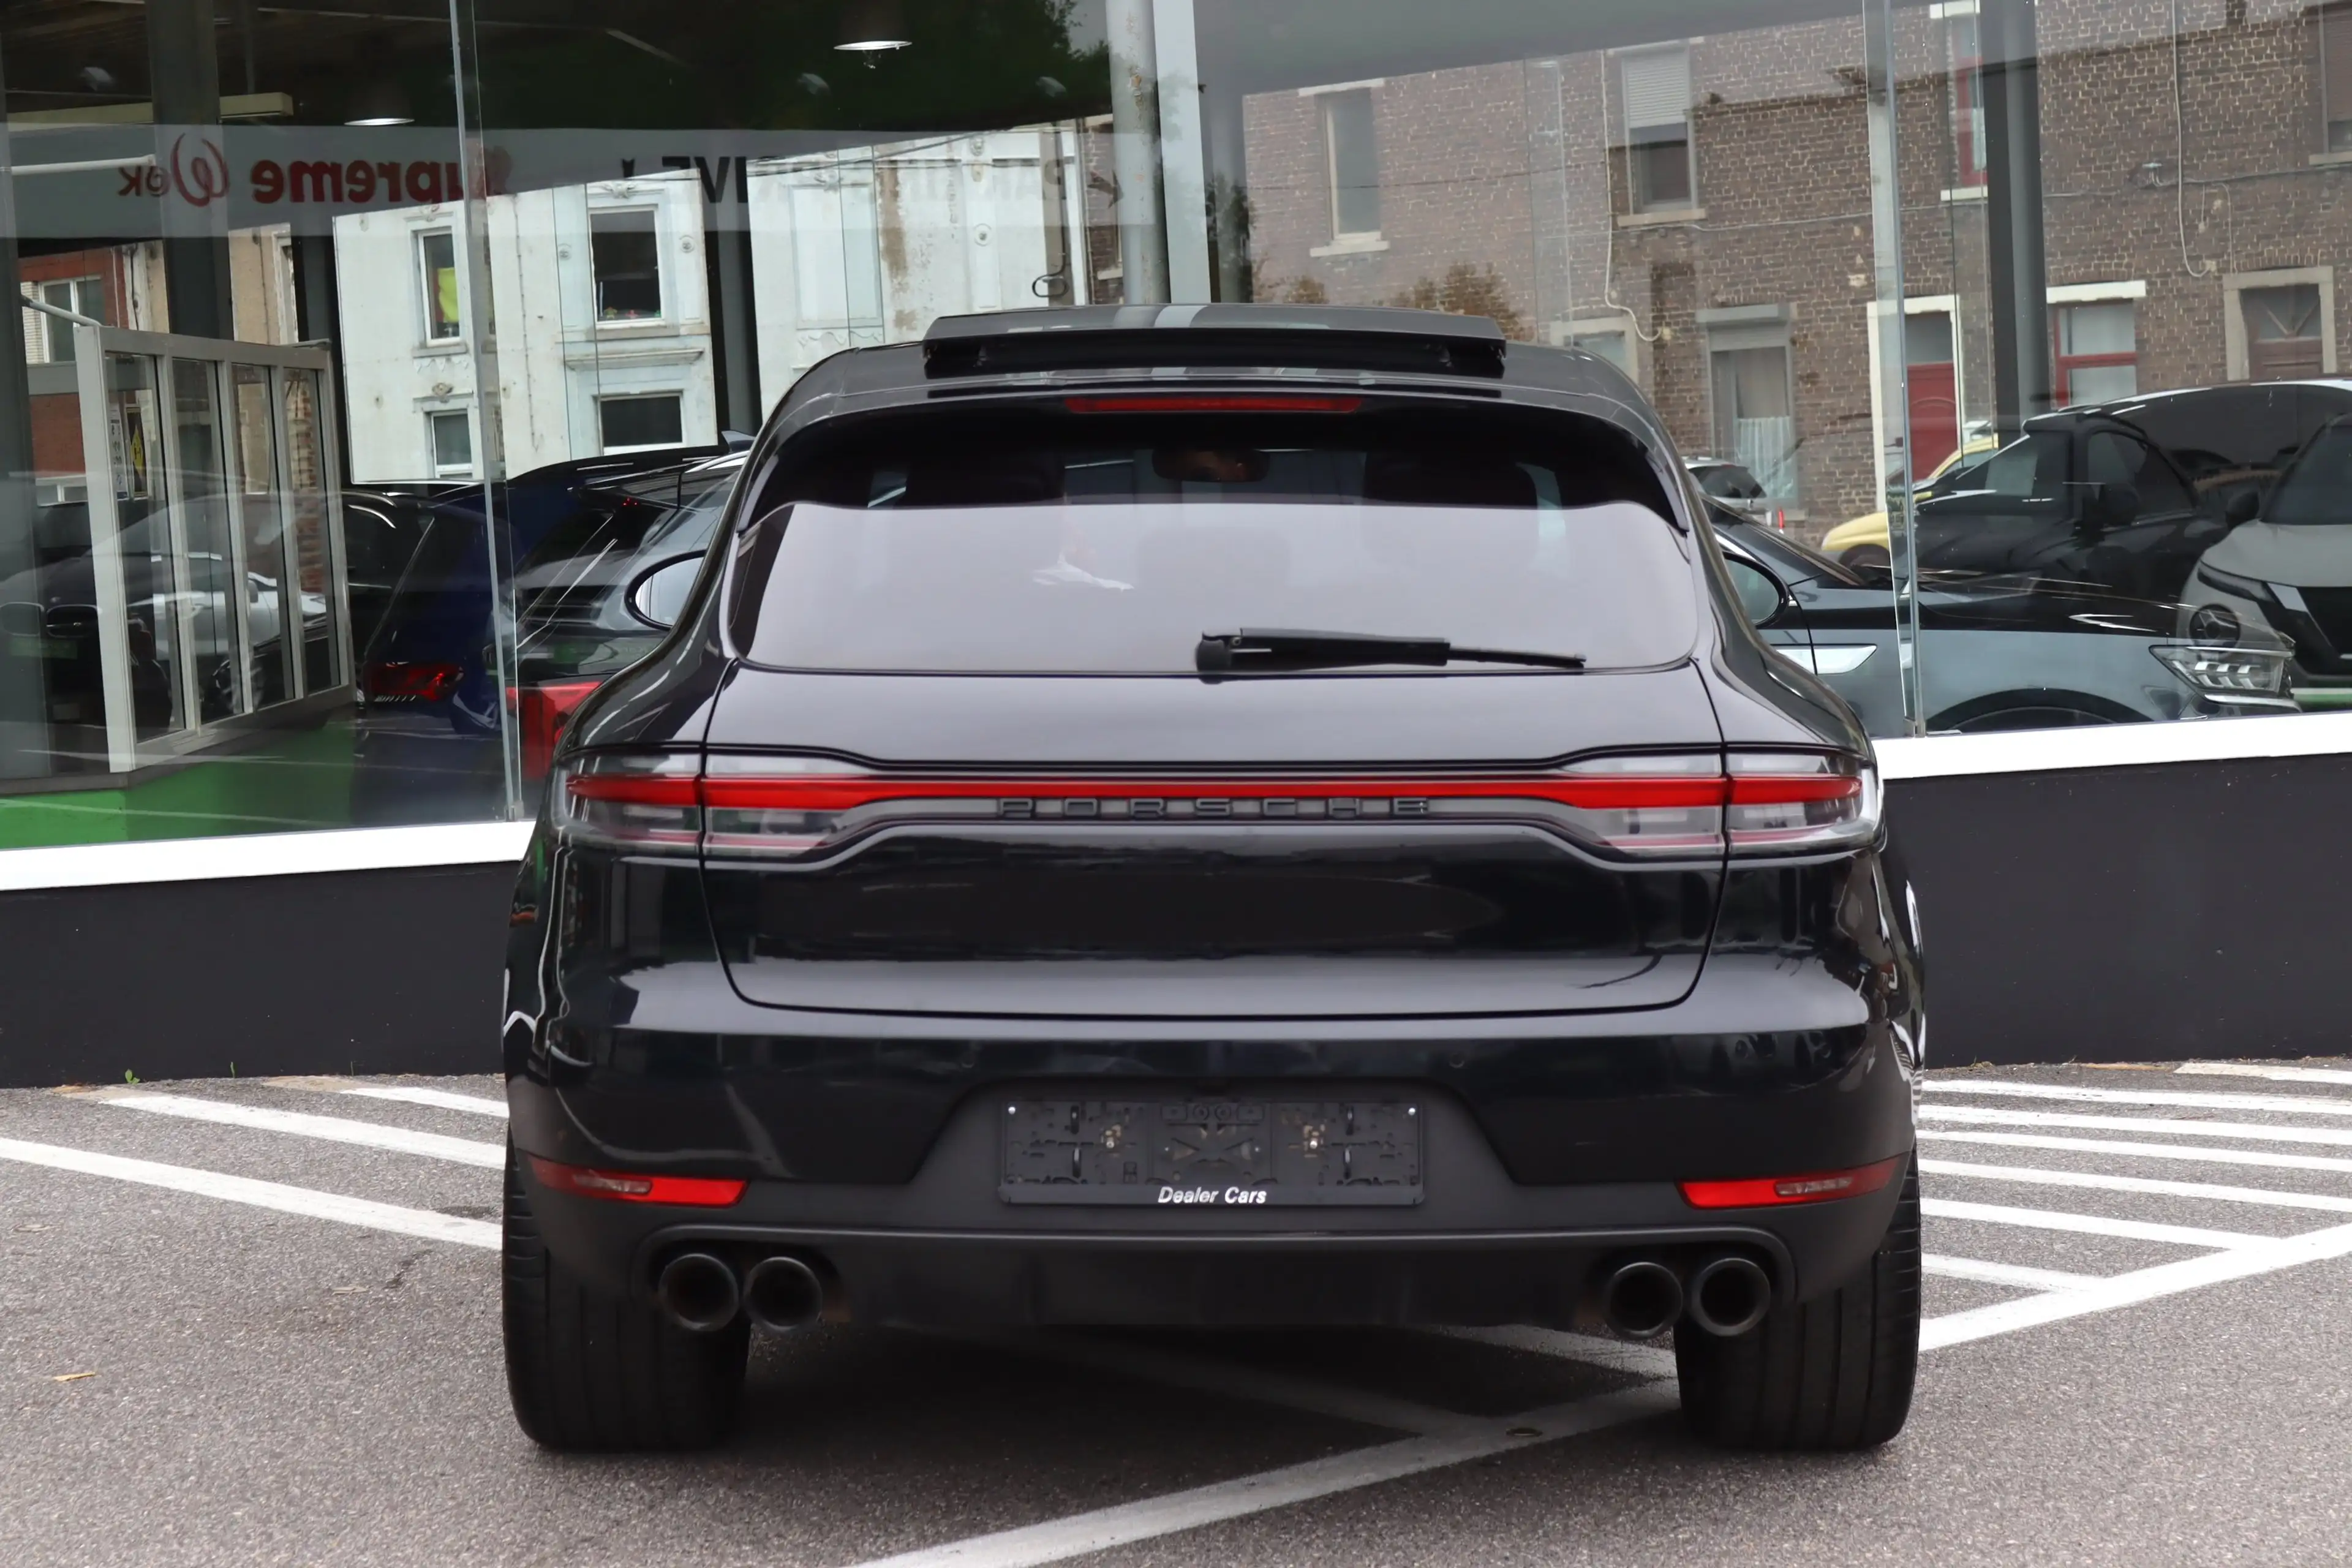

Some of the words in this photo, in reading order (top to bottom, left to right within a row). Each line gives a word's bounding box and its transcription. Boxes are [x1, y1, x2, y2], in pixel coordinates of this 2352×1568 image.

[1000, 797, 1428, 817] PORSCHE
[1158, 1186, 1219, 1204] Dealer
[1224, 1186, 1267, 1204] Cars
